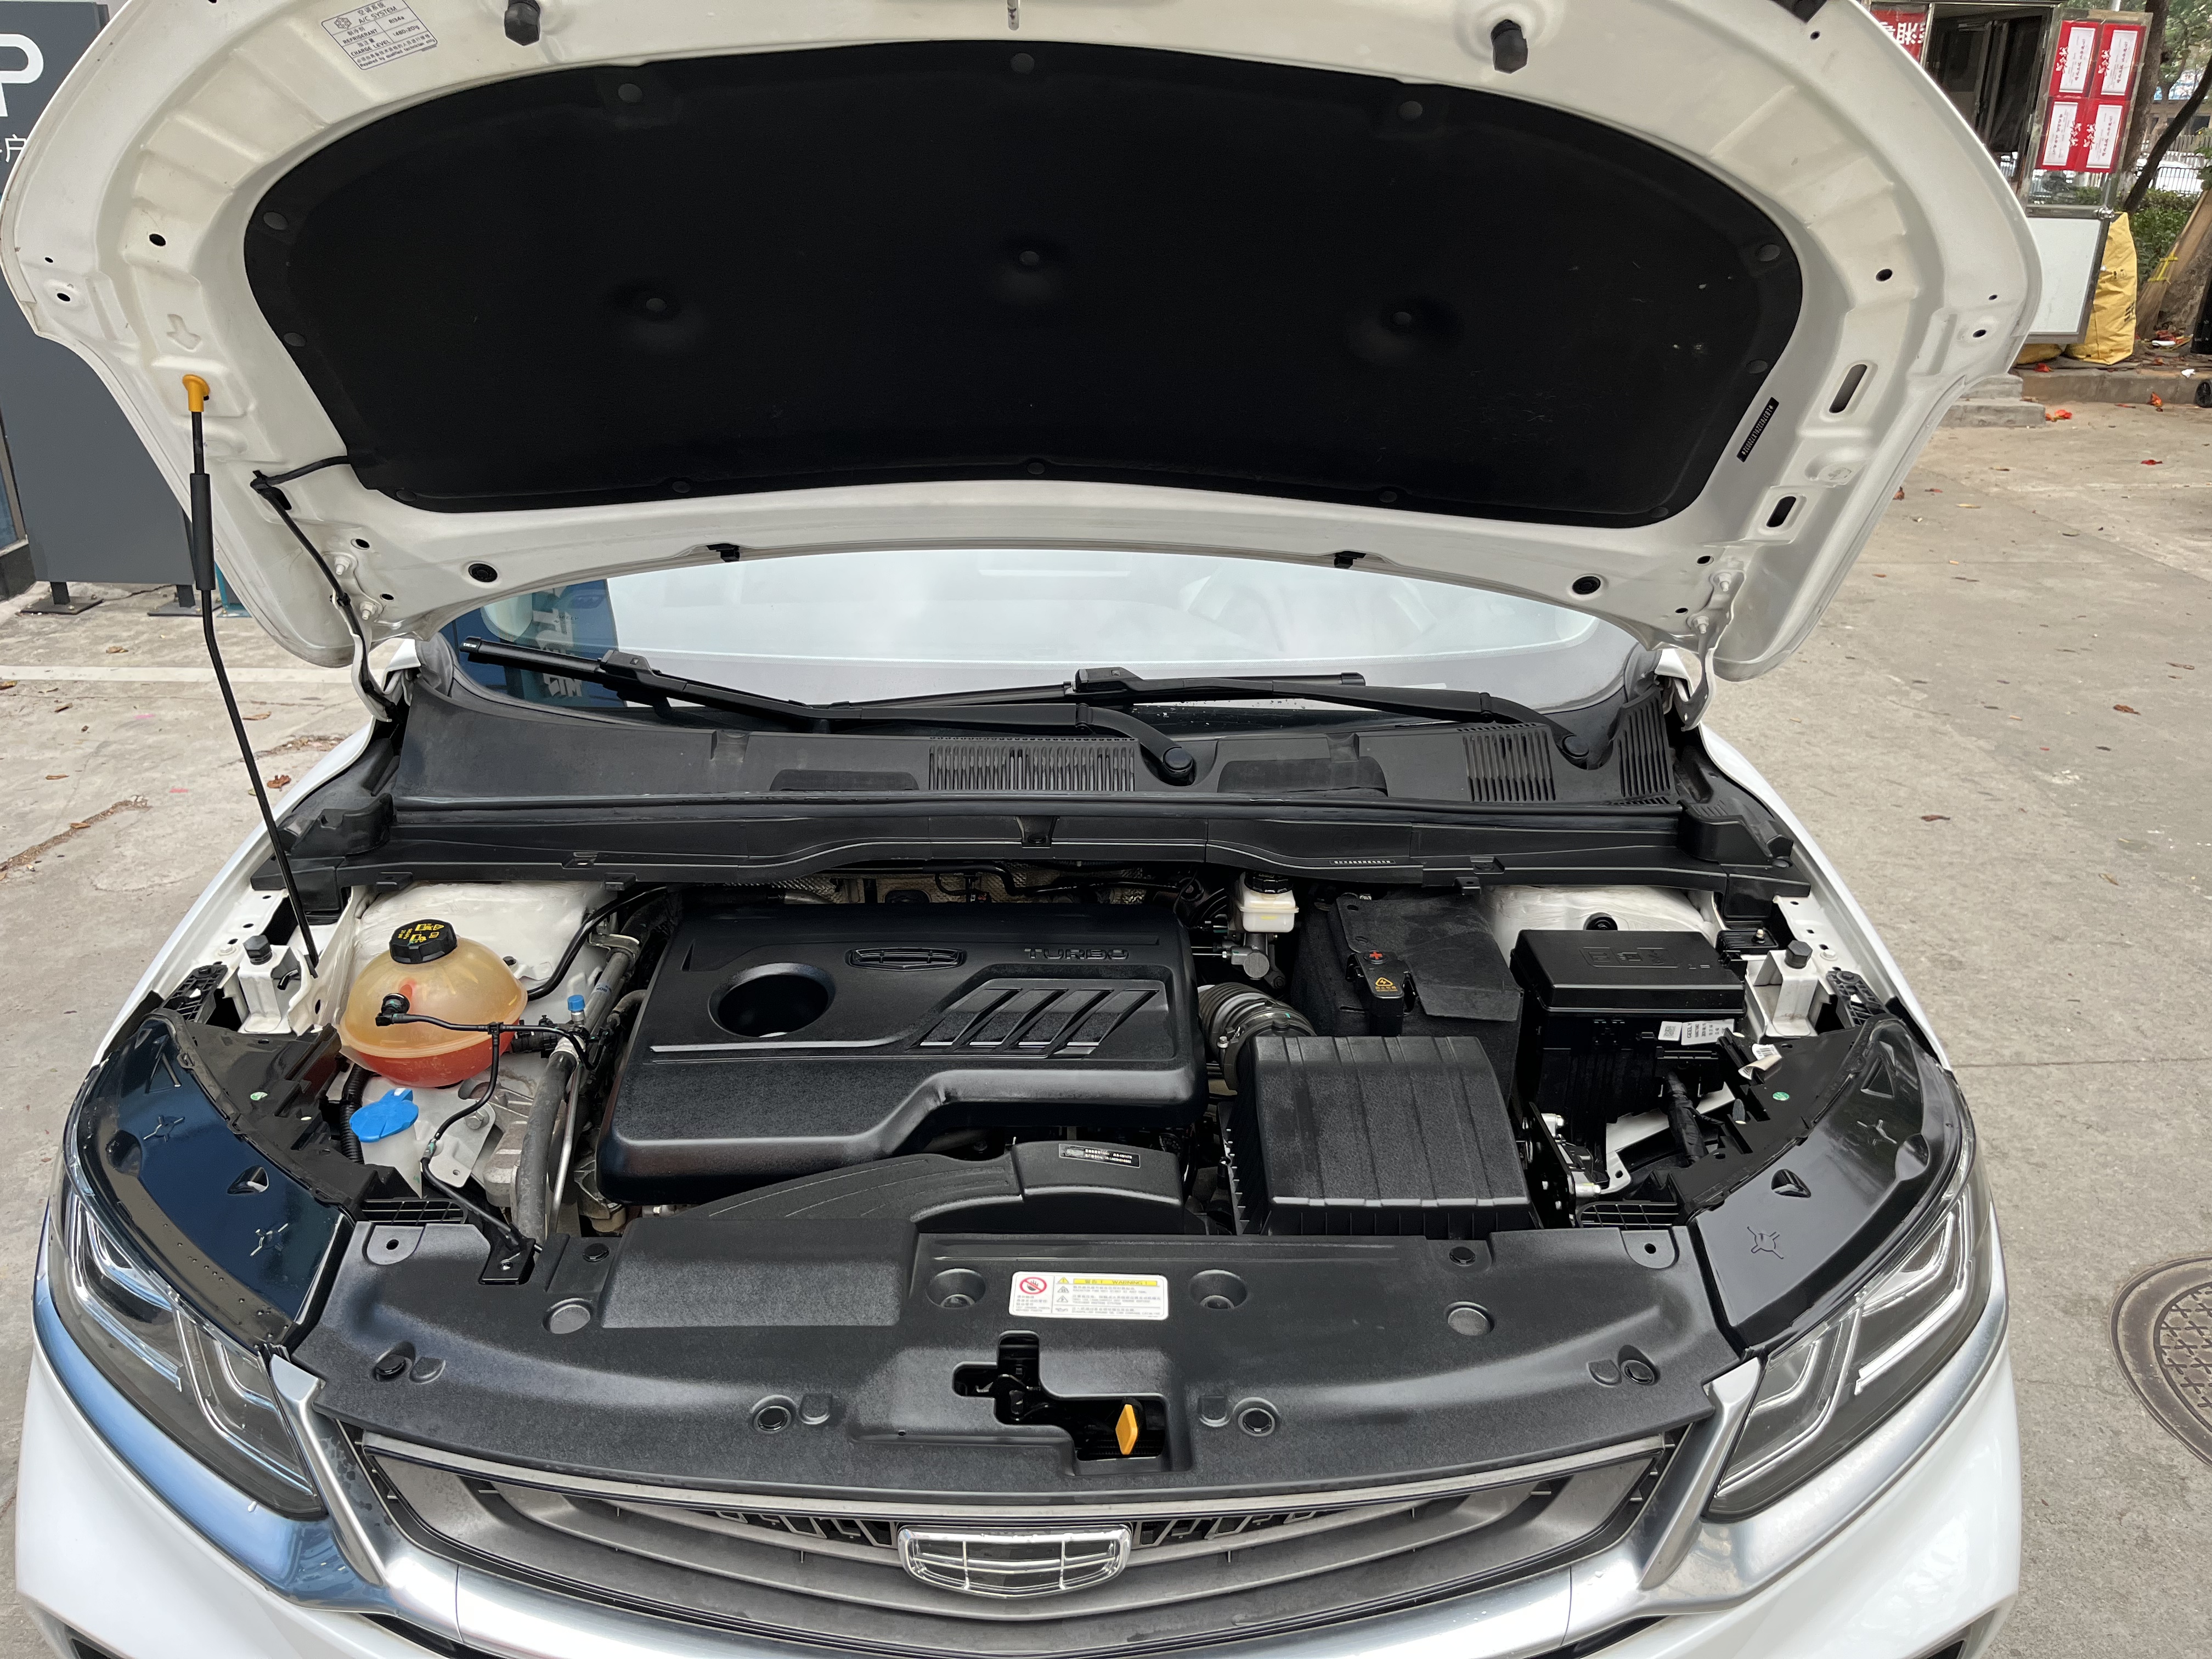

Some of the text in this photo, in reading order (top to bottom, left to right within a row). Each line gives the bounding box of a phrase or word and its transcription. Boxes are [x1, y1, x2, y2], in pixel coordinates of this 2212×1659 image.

[358, 6, 397, 24] A/C SYSTEM
[342, 29, 378, 44] REFRIGERANT
[351, 40, 391, 56] CHARGE LEVEL
[0, 134, 26, 162] 户
[1024, 948, 1129, 960] TURBO
